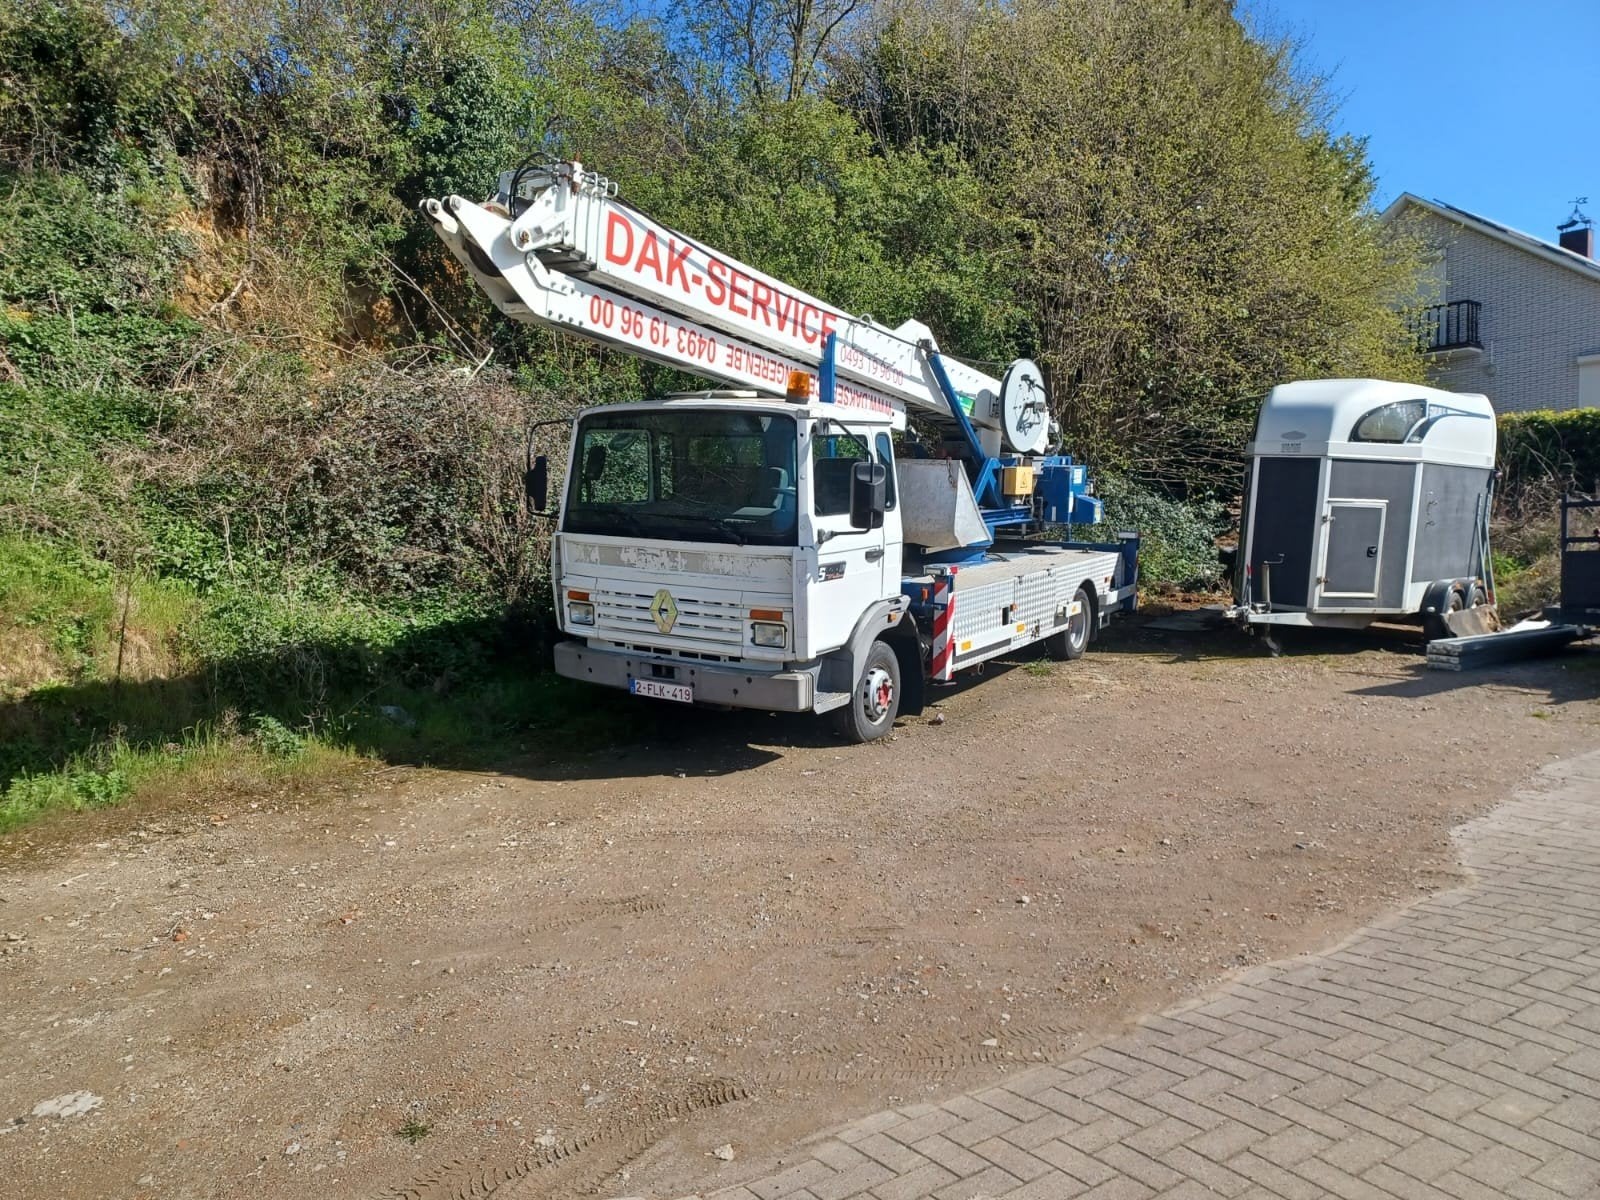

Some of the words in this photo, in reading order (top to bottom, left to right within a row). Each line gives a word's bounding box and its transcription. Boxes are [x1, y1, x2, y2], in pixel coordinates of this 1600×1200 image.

[605, 210, 837, 349] DAK-SERVICE
[590, 294, 614, 328] 00
[621, 305, 644, 339] 96
[650, 316, 670, 348] 19
[677, 326, 717, 363] 0493
[840, 345, 863, 370] 0493
[868, 357, 878, 375] 19
[880, 362, 891, 381] 96
[893, 369, 904, 386] 00
[636, 681, 691, 701] 2-FLK-419
